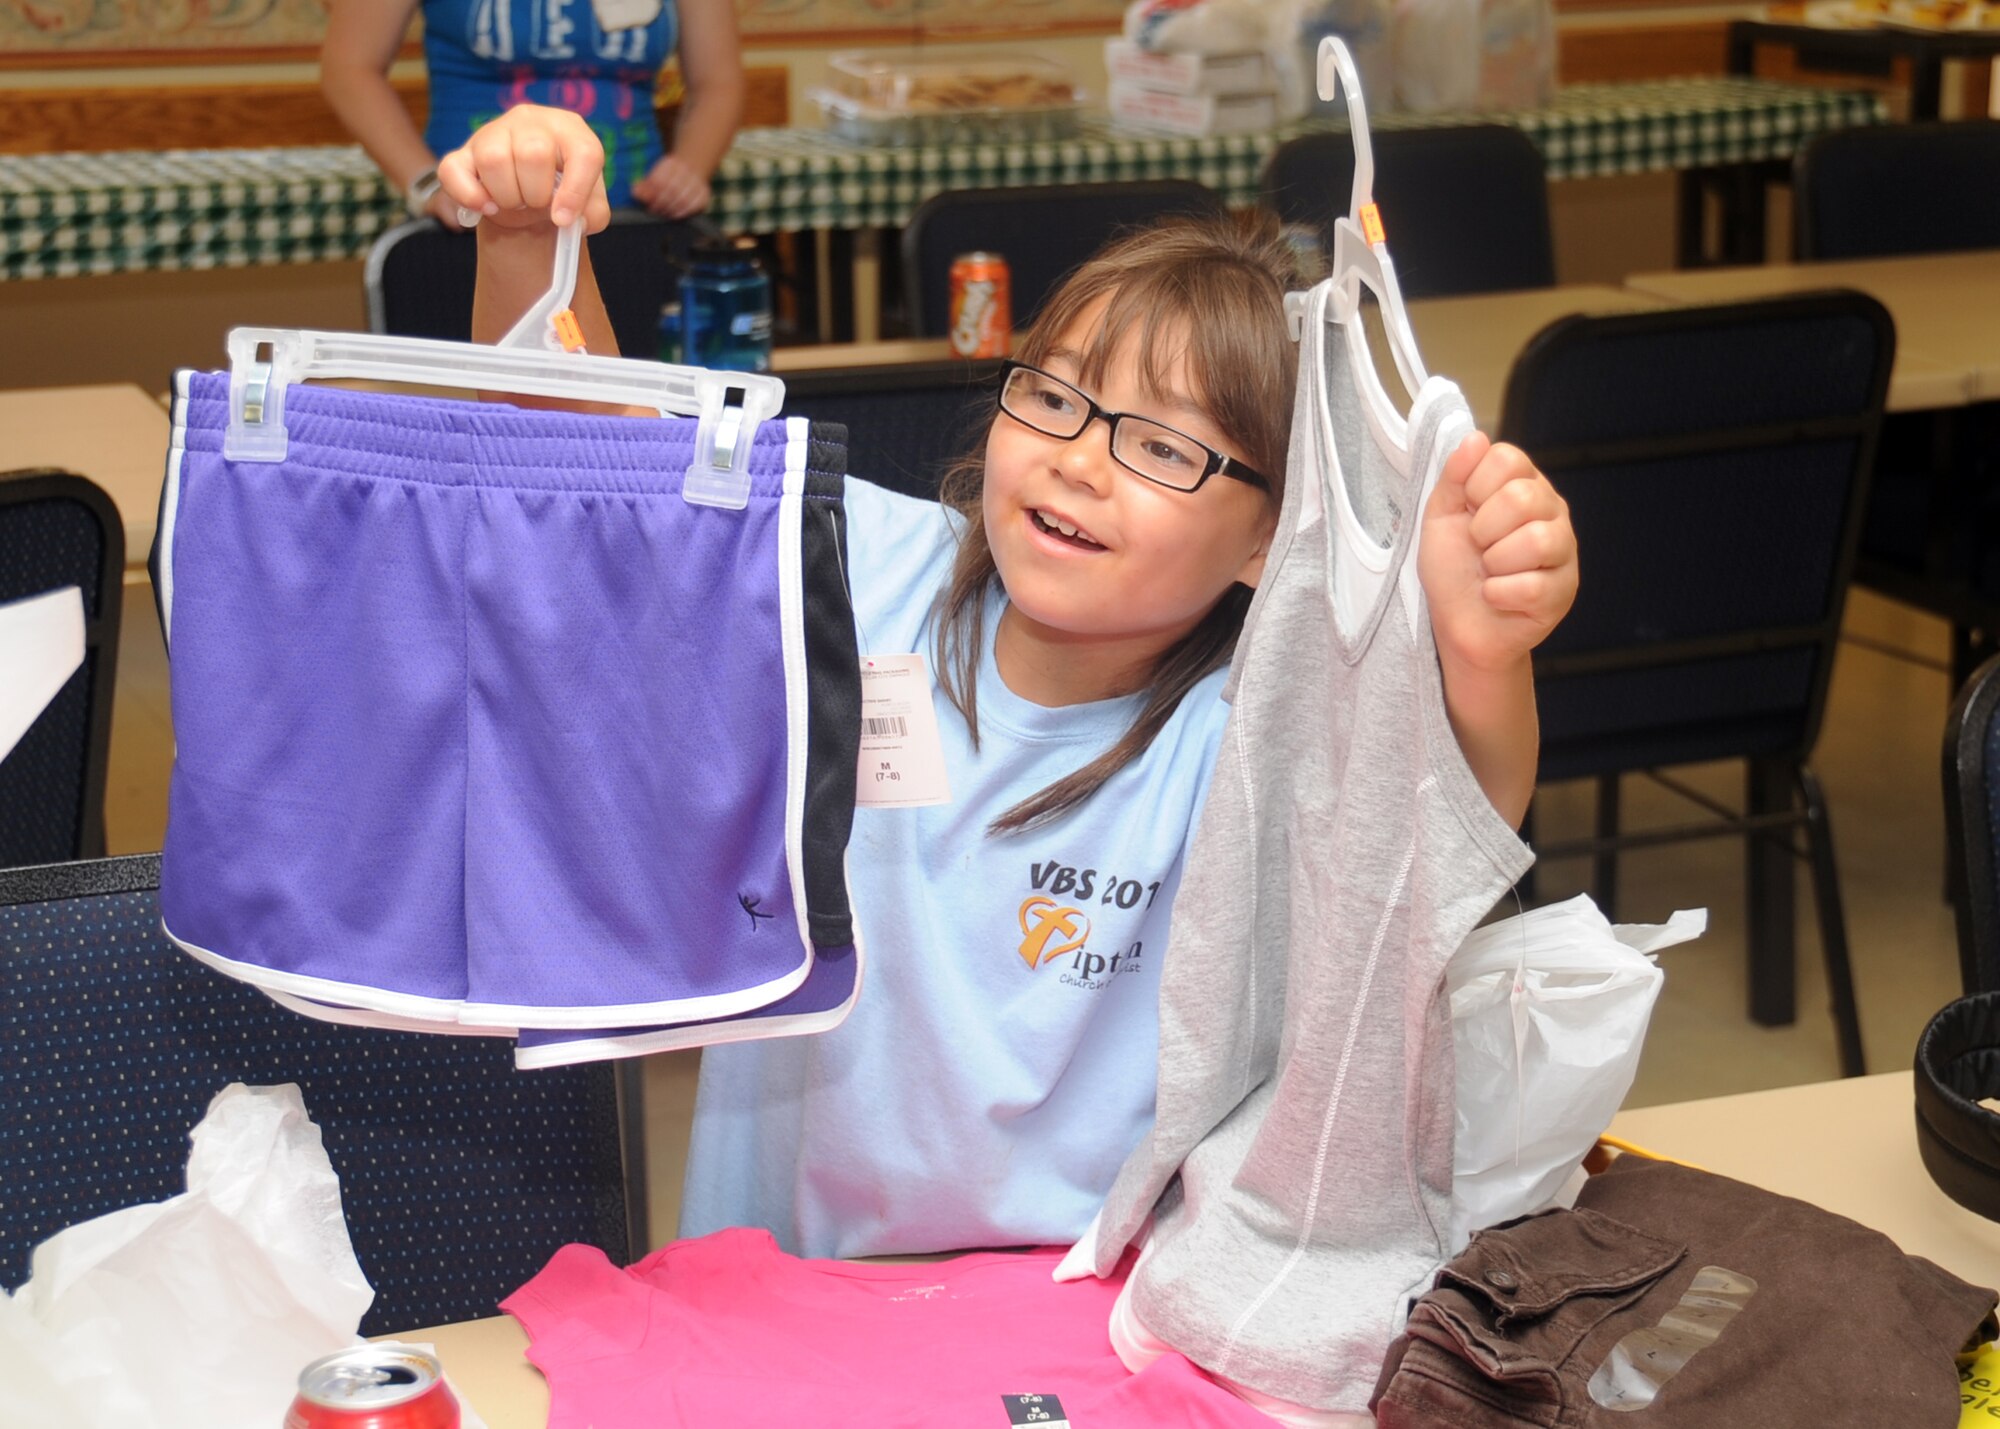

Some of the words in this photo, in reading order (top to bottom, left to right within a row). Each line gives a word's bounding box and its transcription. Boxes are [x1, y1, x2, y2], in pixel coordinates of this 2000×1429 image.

[880, 761, 891, 770] M
[875, 771, 901, 782] (7-8)
[1031, 860, 1097, 900] VBS
